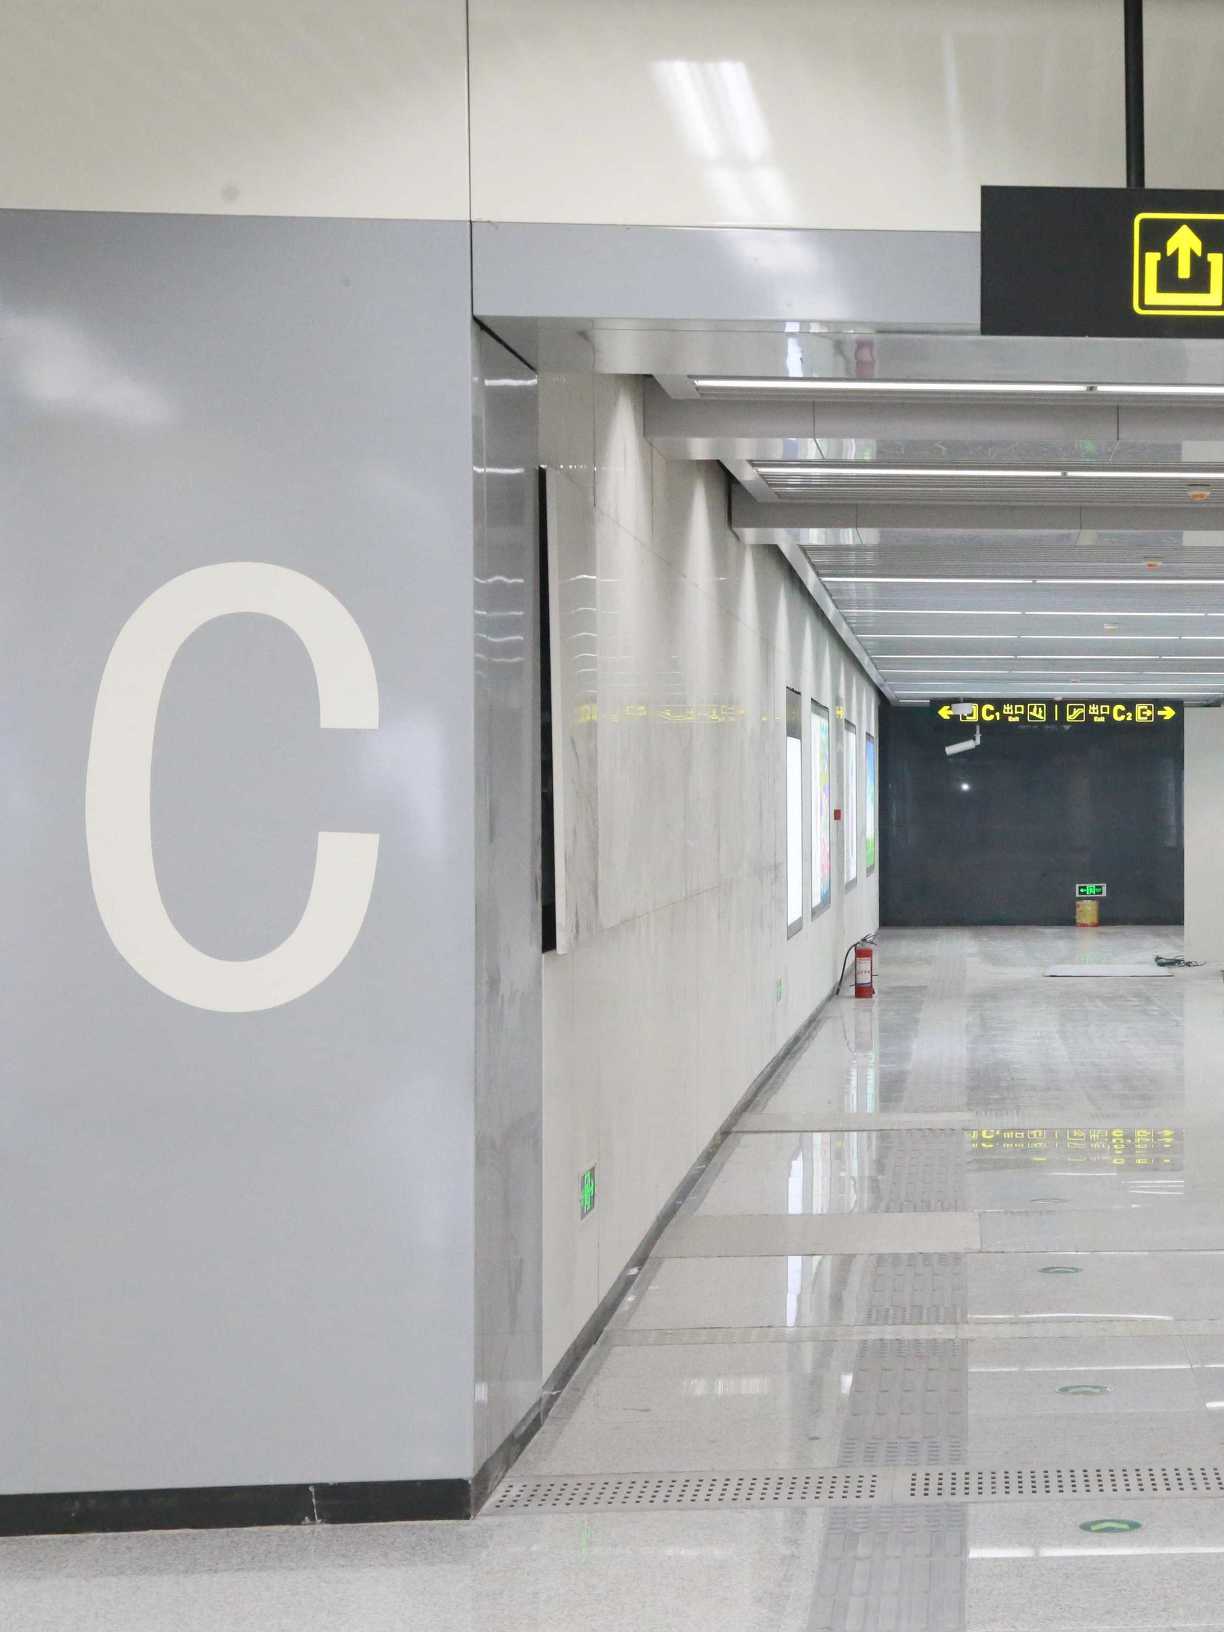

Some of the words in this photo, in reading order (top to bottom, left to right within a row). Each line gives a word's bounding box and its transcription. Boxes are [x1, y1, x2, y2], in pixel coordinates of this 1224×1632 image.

[1003, 703, 1025, 715] 出口
[1088, 703, 1110, 715] 出口
[85, 561, 379, 1013] C
